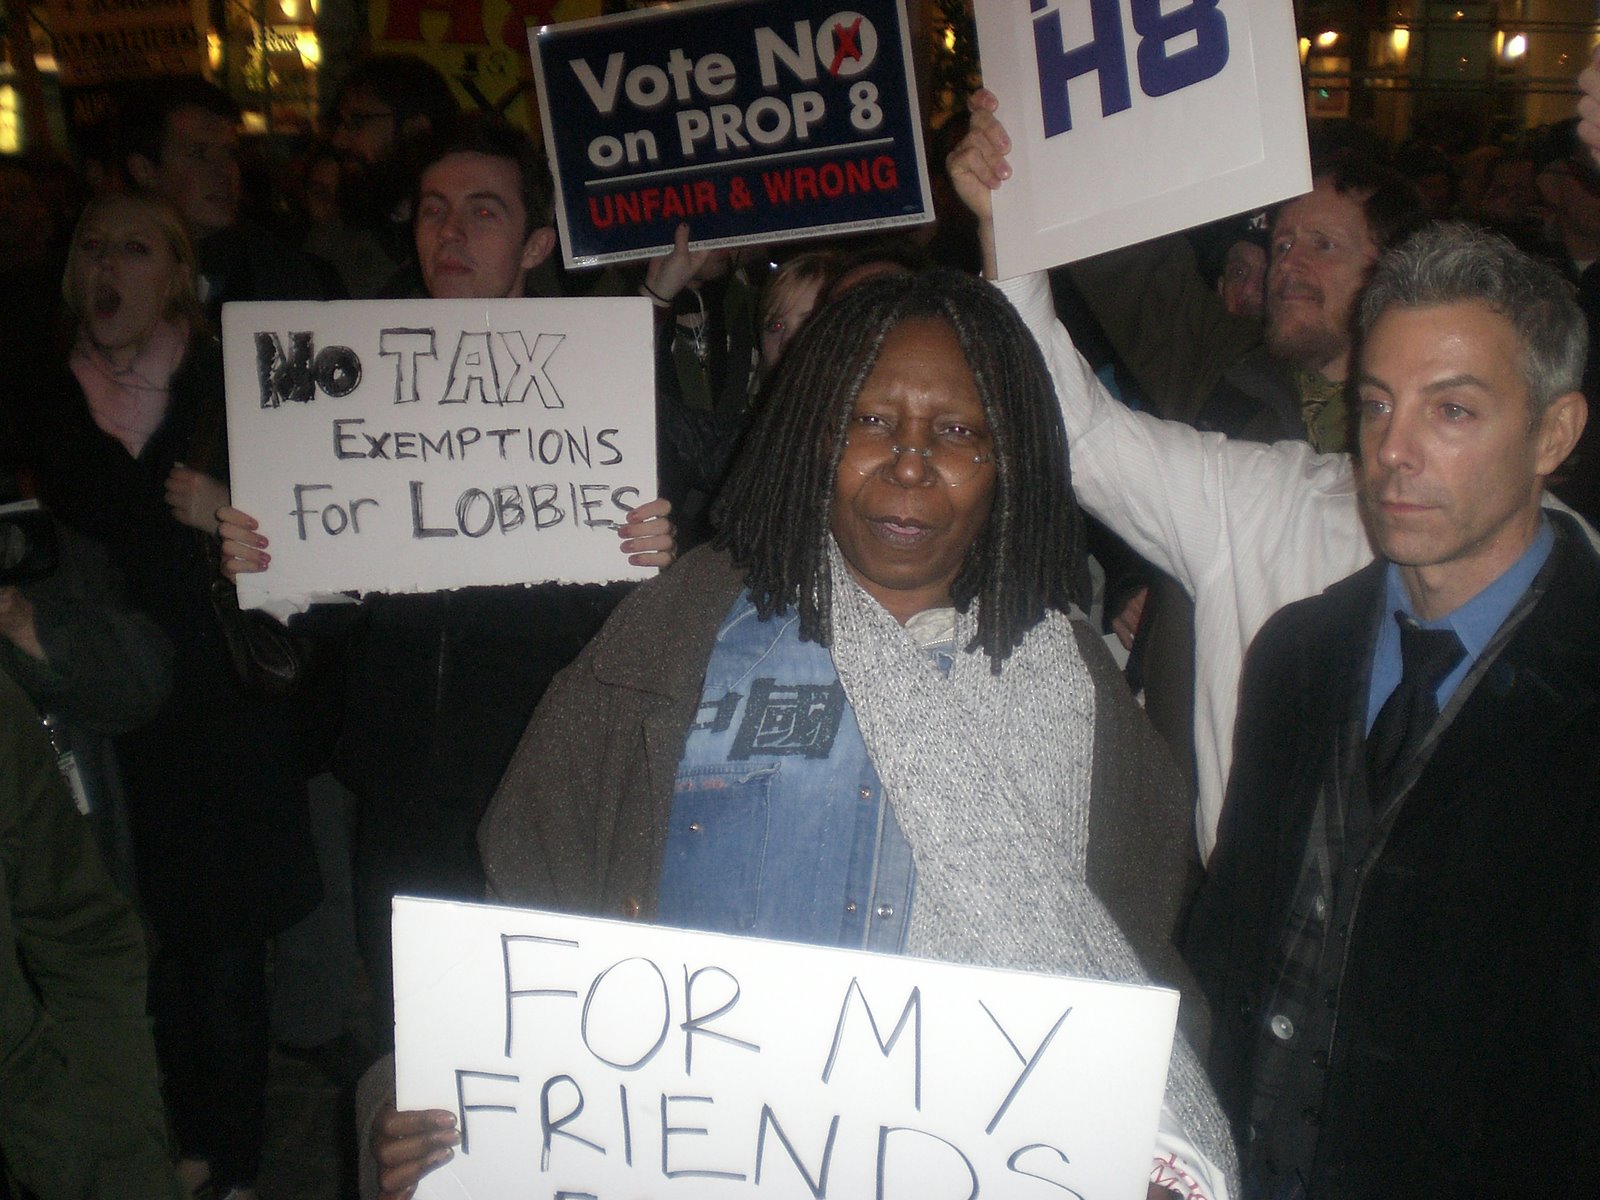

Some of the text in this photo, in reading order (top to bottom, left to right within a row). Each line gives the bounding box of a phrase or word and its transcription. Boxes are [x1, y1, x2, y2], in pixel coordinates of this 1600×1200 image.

[569, 11, 878, 112] Vote NO
[1031, 0, 1230, 139] H8
[588, 82, 883, 167] on PROP 8
[590, 156, 896, 229] UNFAIR & WRONG
[379, 327, 566, 409] TAX
[333, 418, 624, 468] EXEMPTIONS
[411, 482, 641, 539] LOBBIES
[500, 932, 1073, 1134] FOR MY
[454, 1069, 1084, 1200] FRIENDS
